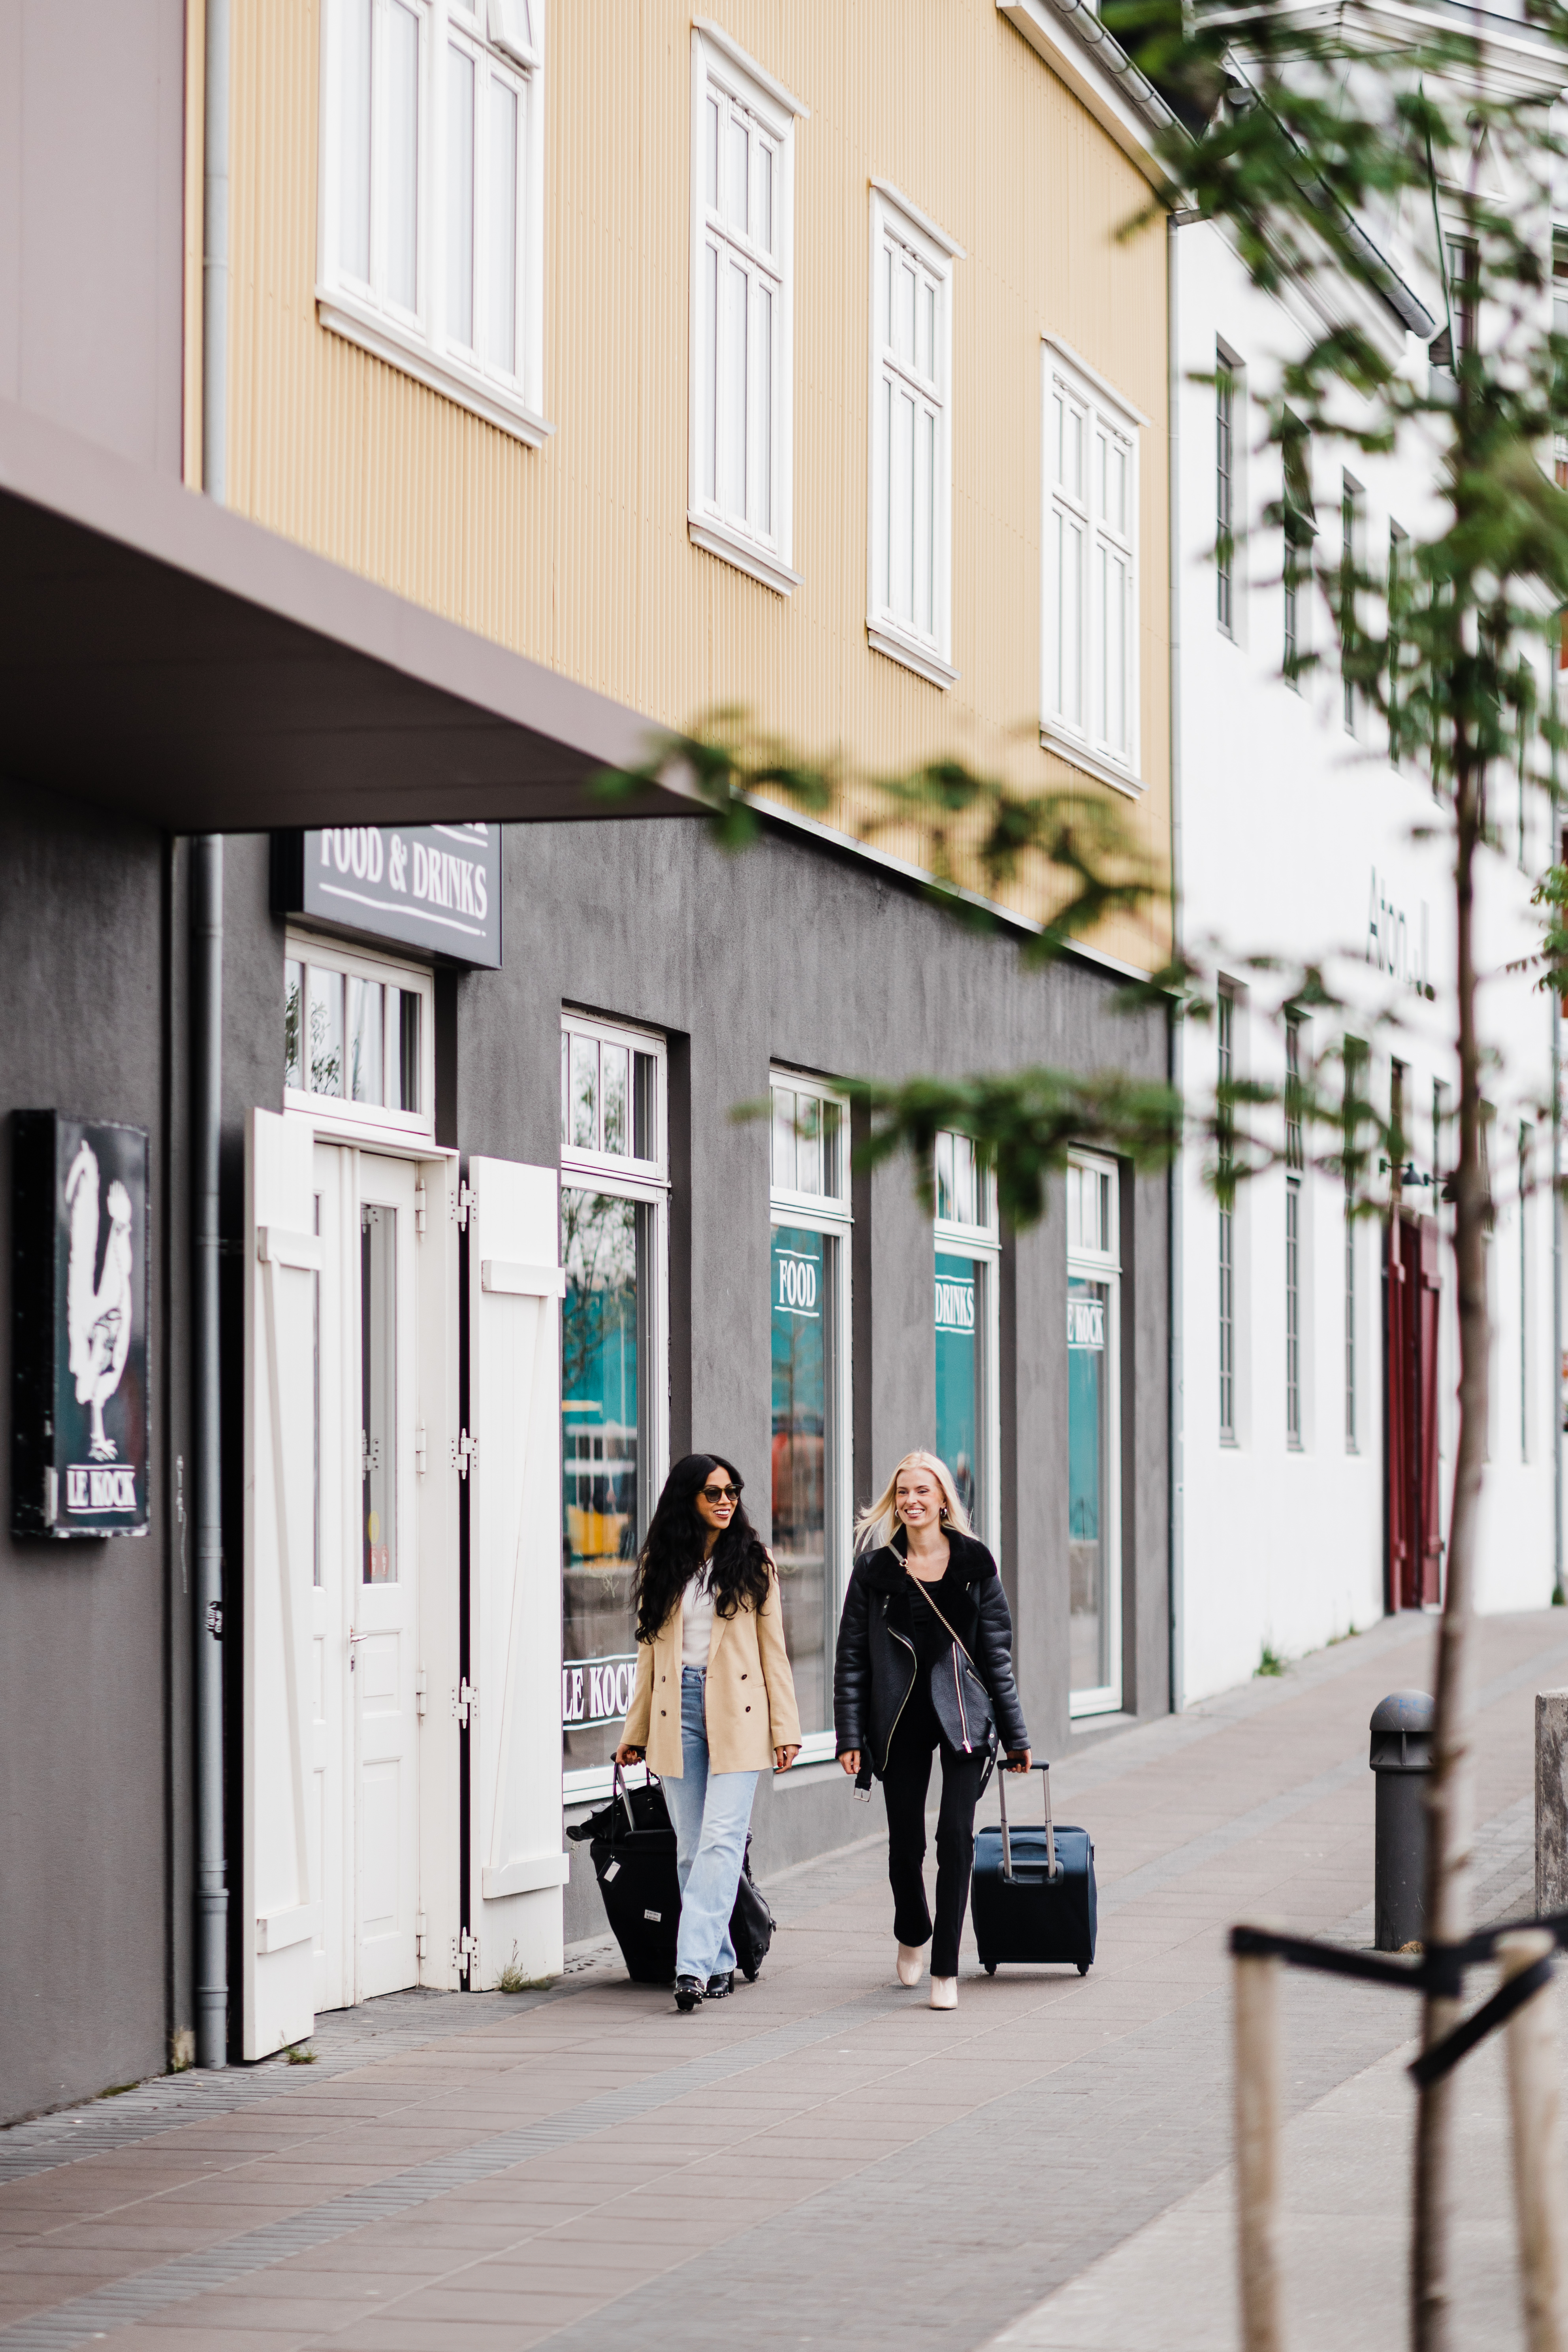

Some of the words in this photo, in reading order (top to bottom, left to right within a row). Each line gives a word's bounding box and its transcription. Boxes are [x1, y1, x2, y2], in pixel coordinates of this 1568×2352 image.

[321, 827, 383, 883] FOOD
[390, 834, 407, 893] &
[413, 841, 488, 920] DRINKS
[779, 1259, 816, 1307] FOOD
[935, 1282, 975, 1328] DRINKS
[1075, 1305, 1104, 1343] KOCK
[67, 1470, 88, 1506] LE
[90, 1470, 137, 1506] KOCK
[563, 1667, 584, 1721] LE
